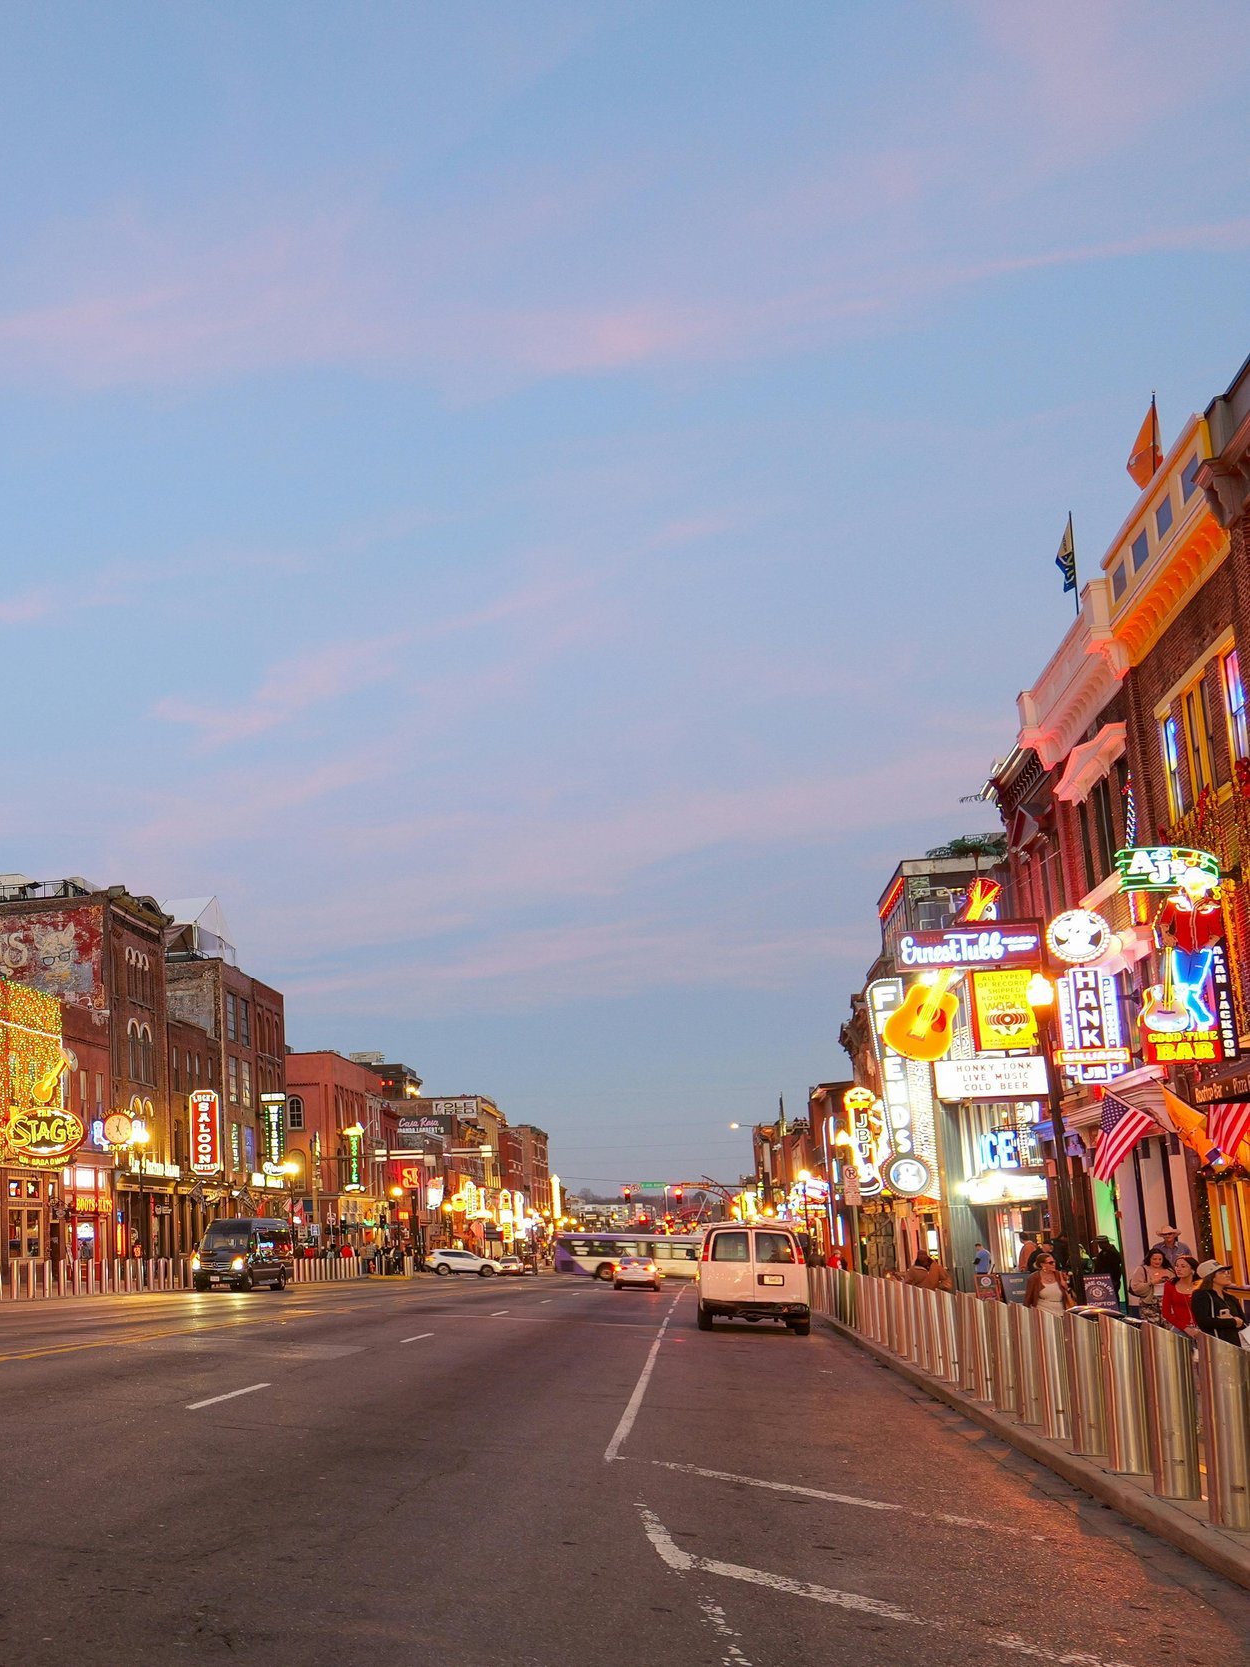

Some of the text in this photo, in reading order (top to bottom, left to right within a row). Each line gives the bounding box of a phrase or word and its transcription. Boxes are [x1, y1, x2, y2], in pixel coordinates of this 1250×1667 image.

[900, 934, 959, 965] Ernest
[943, 932, 1005, 961] Tubb
[1212, 946, 1227, 984] ALAN
[984, 1001, 1028, 1011] WORLD
[1075, 972, 1102, 1047] HANK
[1218, 991, 1236, 1058] JACKSON
[1147, 1030, 1219, 1043] GOOD TIME
[1062, 1049, 1127, 1062] WILLIAMS
[1155, 1042, 1216, 1061] BAR
[956, 1062, 1033, 1073] HONKY TONK
[1083, 1065, 1107, 1080] JR
[962, 1072, 1030, 1083] LIVE MUSIC
[964, 1081, 1029, 1092] COLD BEER
[192, 1094, 216, 1103] LUCKY
[443, 1101, 474, 1109] OLE
[398, 1116, 440, 1128] Casa Rosa
[10, 1115, 81, 1148] STAGE
[197, 1102, 212, 1164] SALOON
[268, 1105, 280, 1164] WHISKEY
[102, 1143, 134, 1151] BOOTS
[76, 1199, 96, 1212] BOOTS
